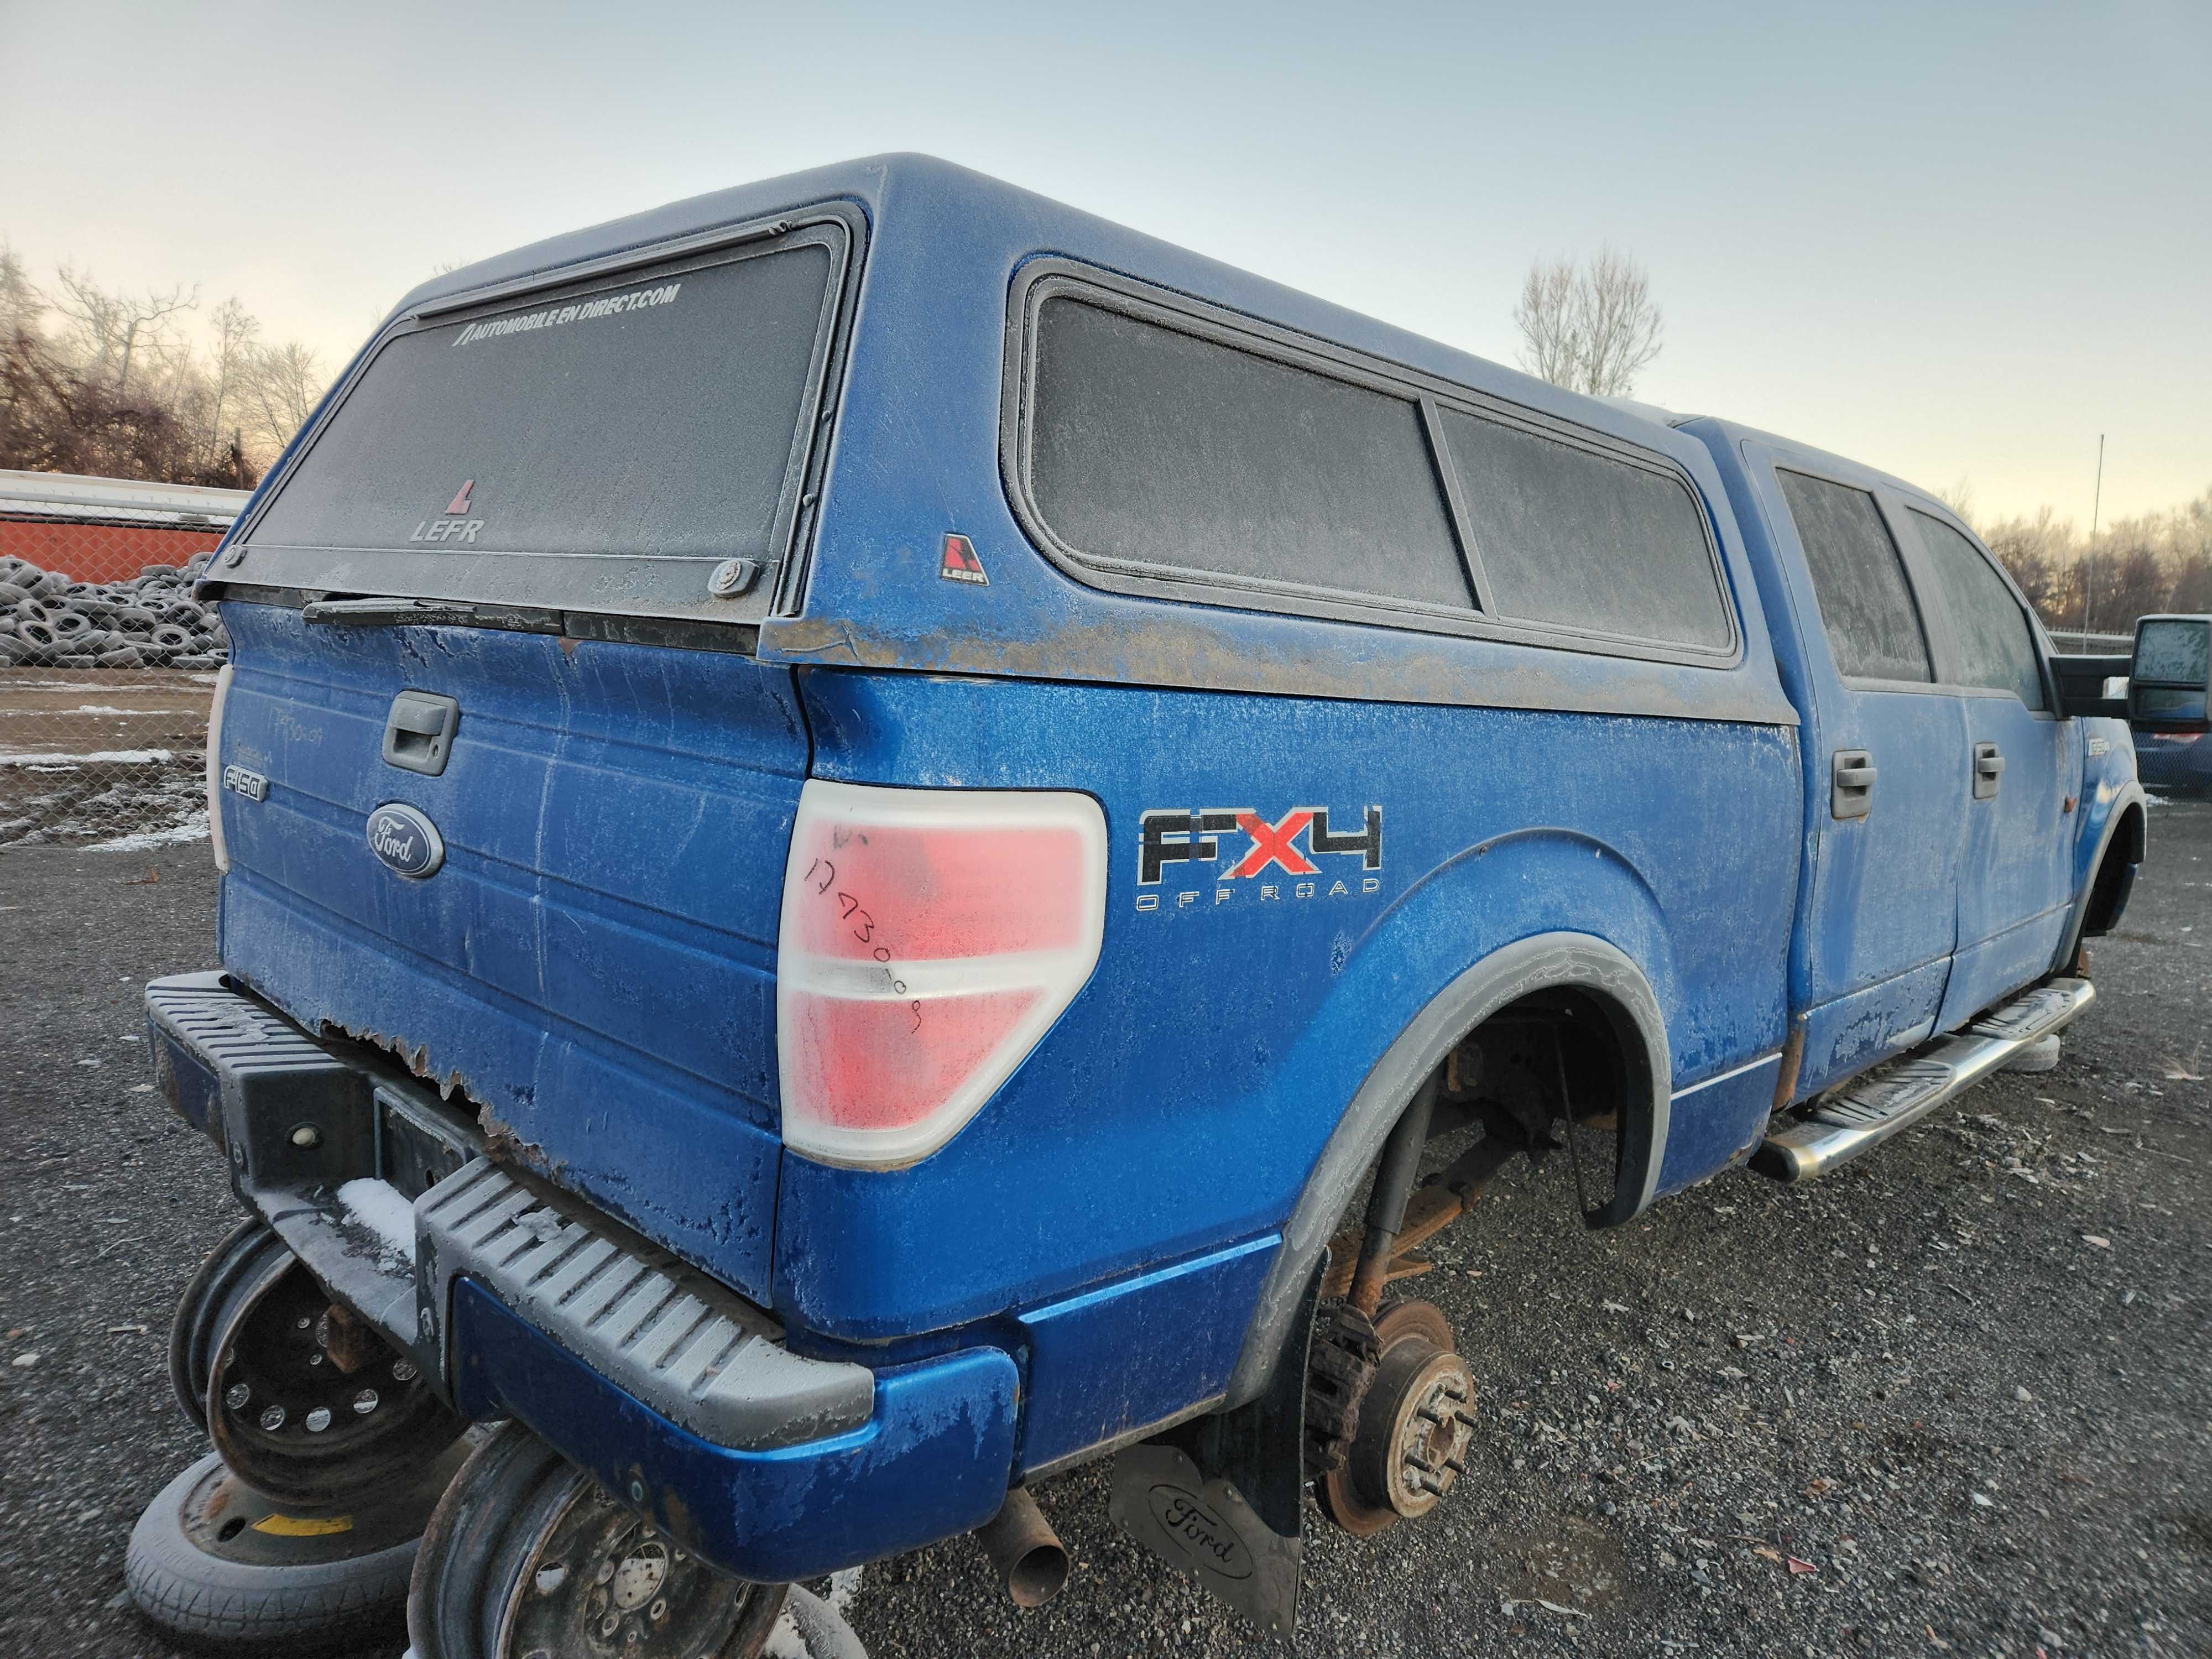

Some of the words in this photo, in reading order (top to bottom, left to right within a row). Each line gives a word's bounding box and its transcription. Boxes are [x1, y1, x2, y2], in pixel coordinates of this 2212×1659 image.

[470, 309, 560, 341] AUTOMOBILE
[555, 305, 581, 324] EN
[577, 283, 681, 320] DIRECT.COM
[942, 568, 985, 582] LEER
[373, 816, 414, 862] Ford
[1137, 805, 1382, 886] FX4
[1136, 888, 1235, 911] OFF
[1260, 878, 1380, 901] ROAD
[1165, 1498, 1234, 1563] Ford
